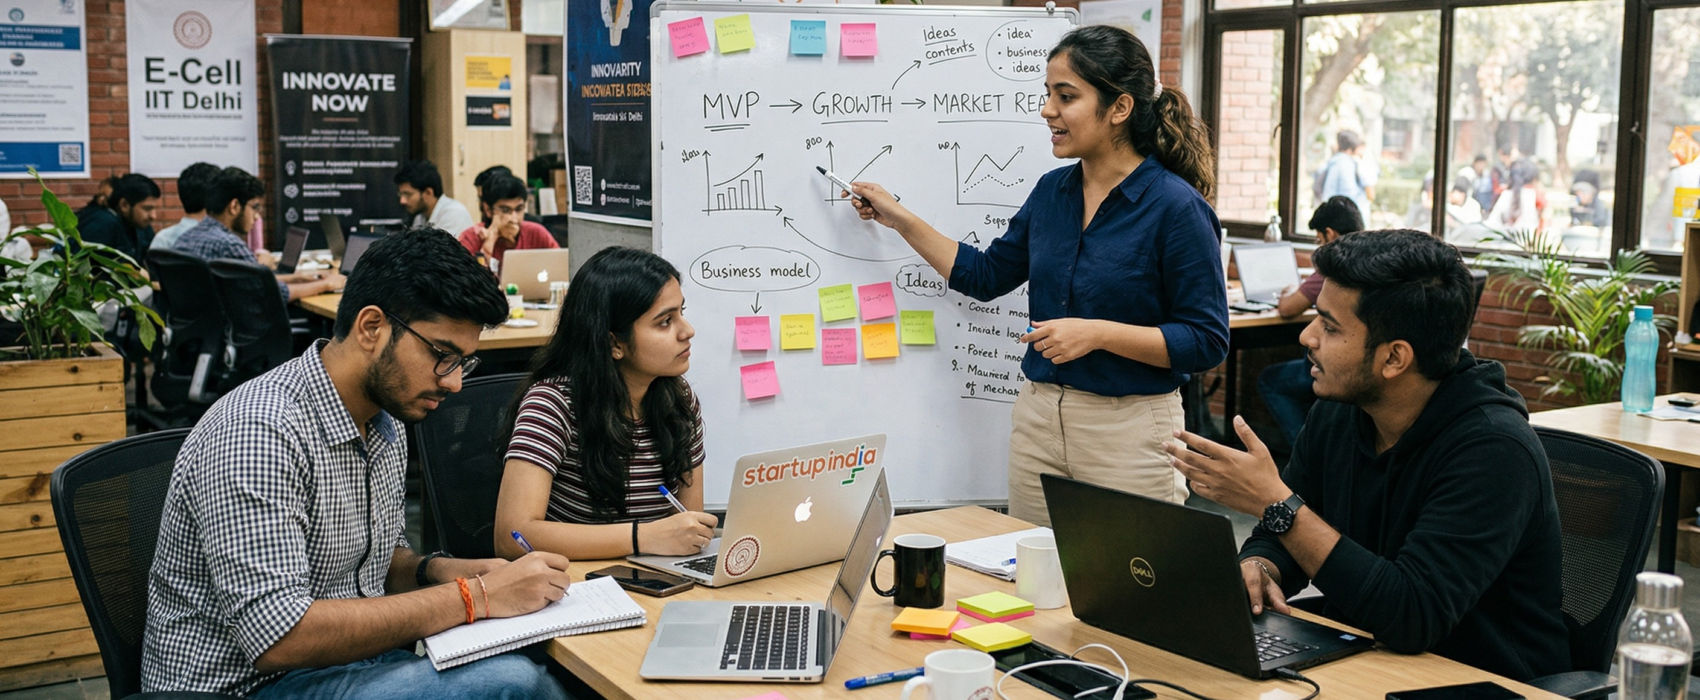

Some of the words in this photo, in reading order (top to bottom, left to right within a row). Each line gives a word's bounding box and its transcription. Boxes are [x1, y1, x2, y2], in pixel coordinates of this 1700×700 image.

[923, 25, 957, 42] Ideas
[925, 39, 975, 60] contents
[1007, 45, 1048, 58] business
[145, 57, 242, 85] E-Cell
[591, 61, 641, 78] INNOVARITY
[1012, 59, 1041, 73] ideas
[282, 71, 396, 91] INNOVATE
[146, 90, 174, 109] IIT
[182, 91, 242, 110] Delhi
[312, 94, 369, 112] NOW
[703, 91, 760, 120] MVP
[812, 91, 892, 118] GROWTH
[933, 92, 1005, 114] MARKET
[1015, 91, 1050, 115] REA
[701, 260, 762, 280] Business
[770, 262, 812, 279] model
[904, 271, 944, 291] Ideas
[965, 381, 977, 396] of
